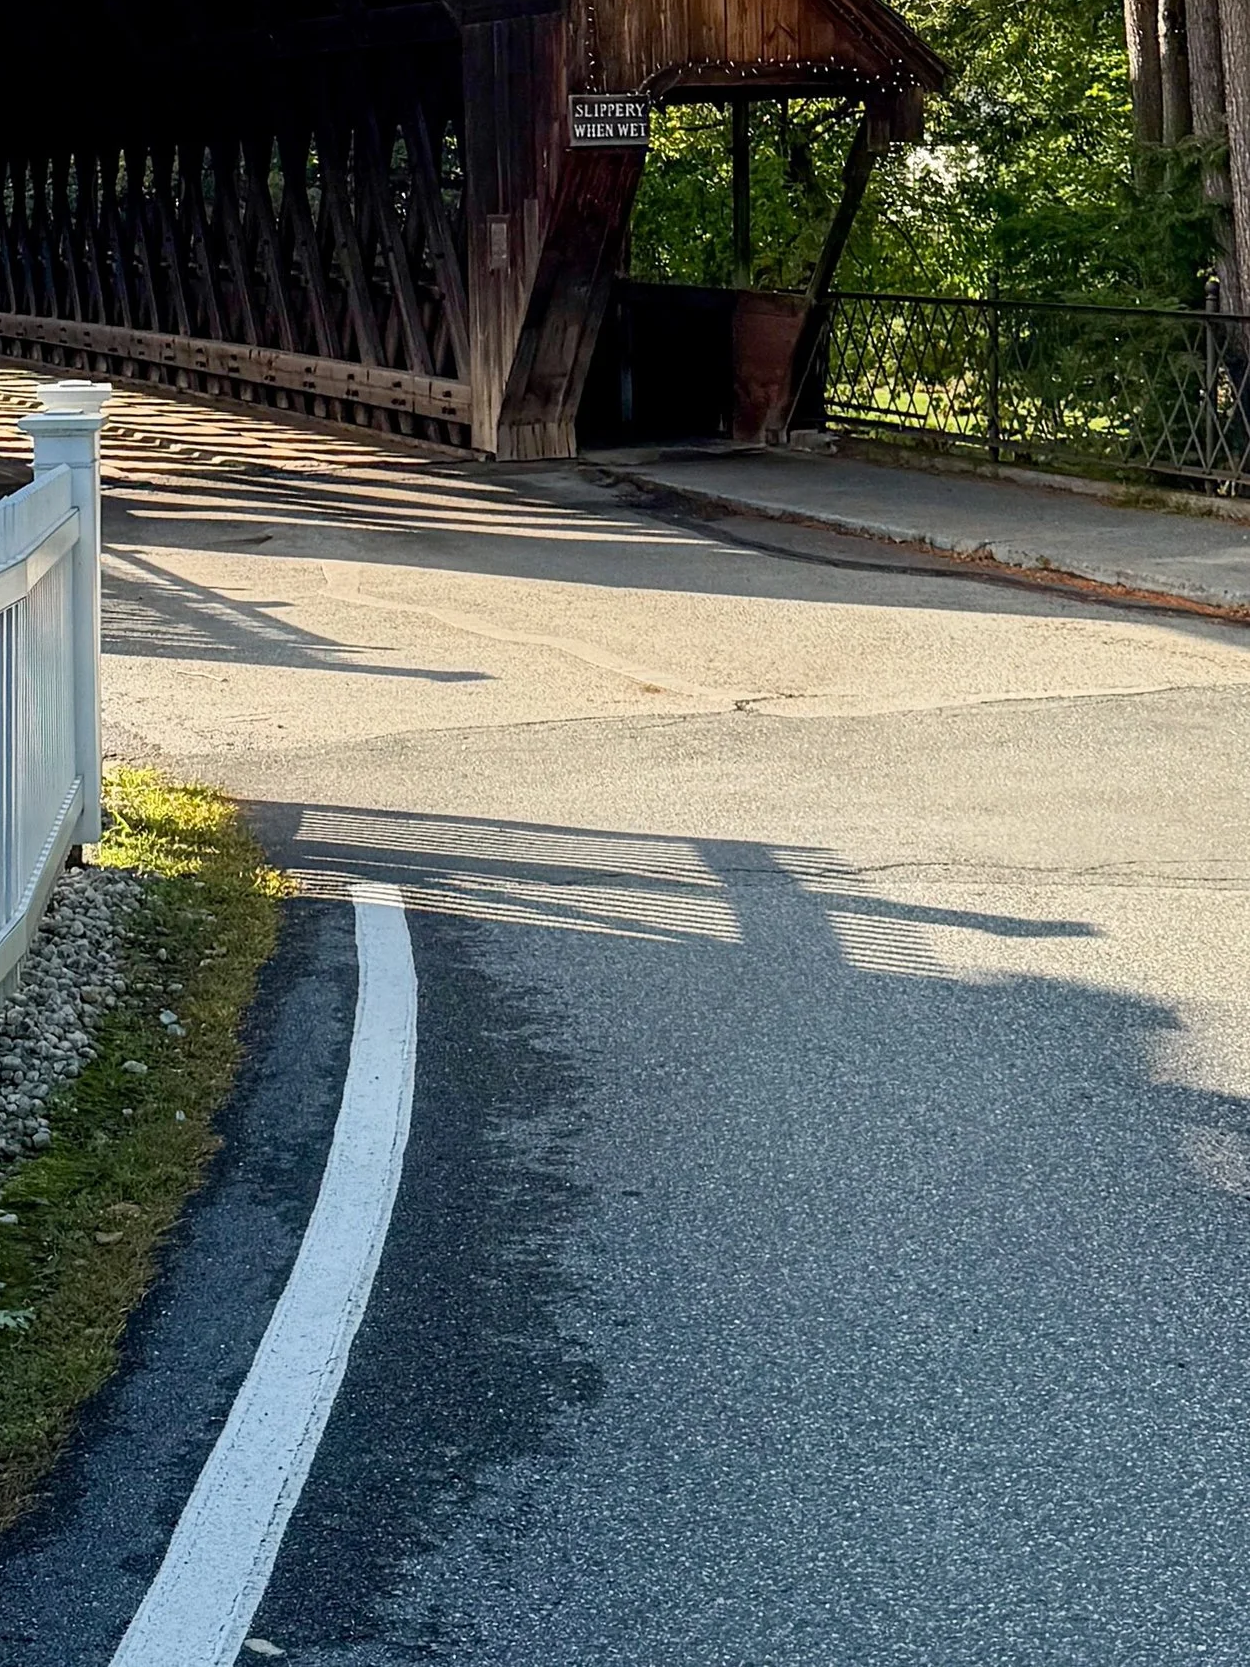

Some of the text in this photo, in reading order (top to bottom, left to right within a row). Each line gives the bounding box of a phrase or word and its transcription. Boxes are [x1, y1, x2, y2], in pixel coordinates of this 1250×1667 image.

[574, 103, 645, 118] SLIPPERY
[573, 122, 647, 138] WHEN WET
